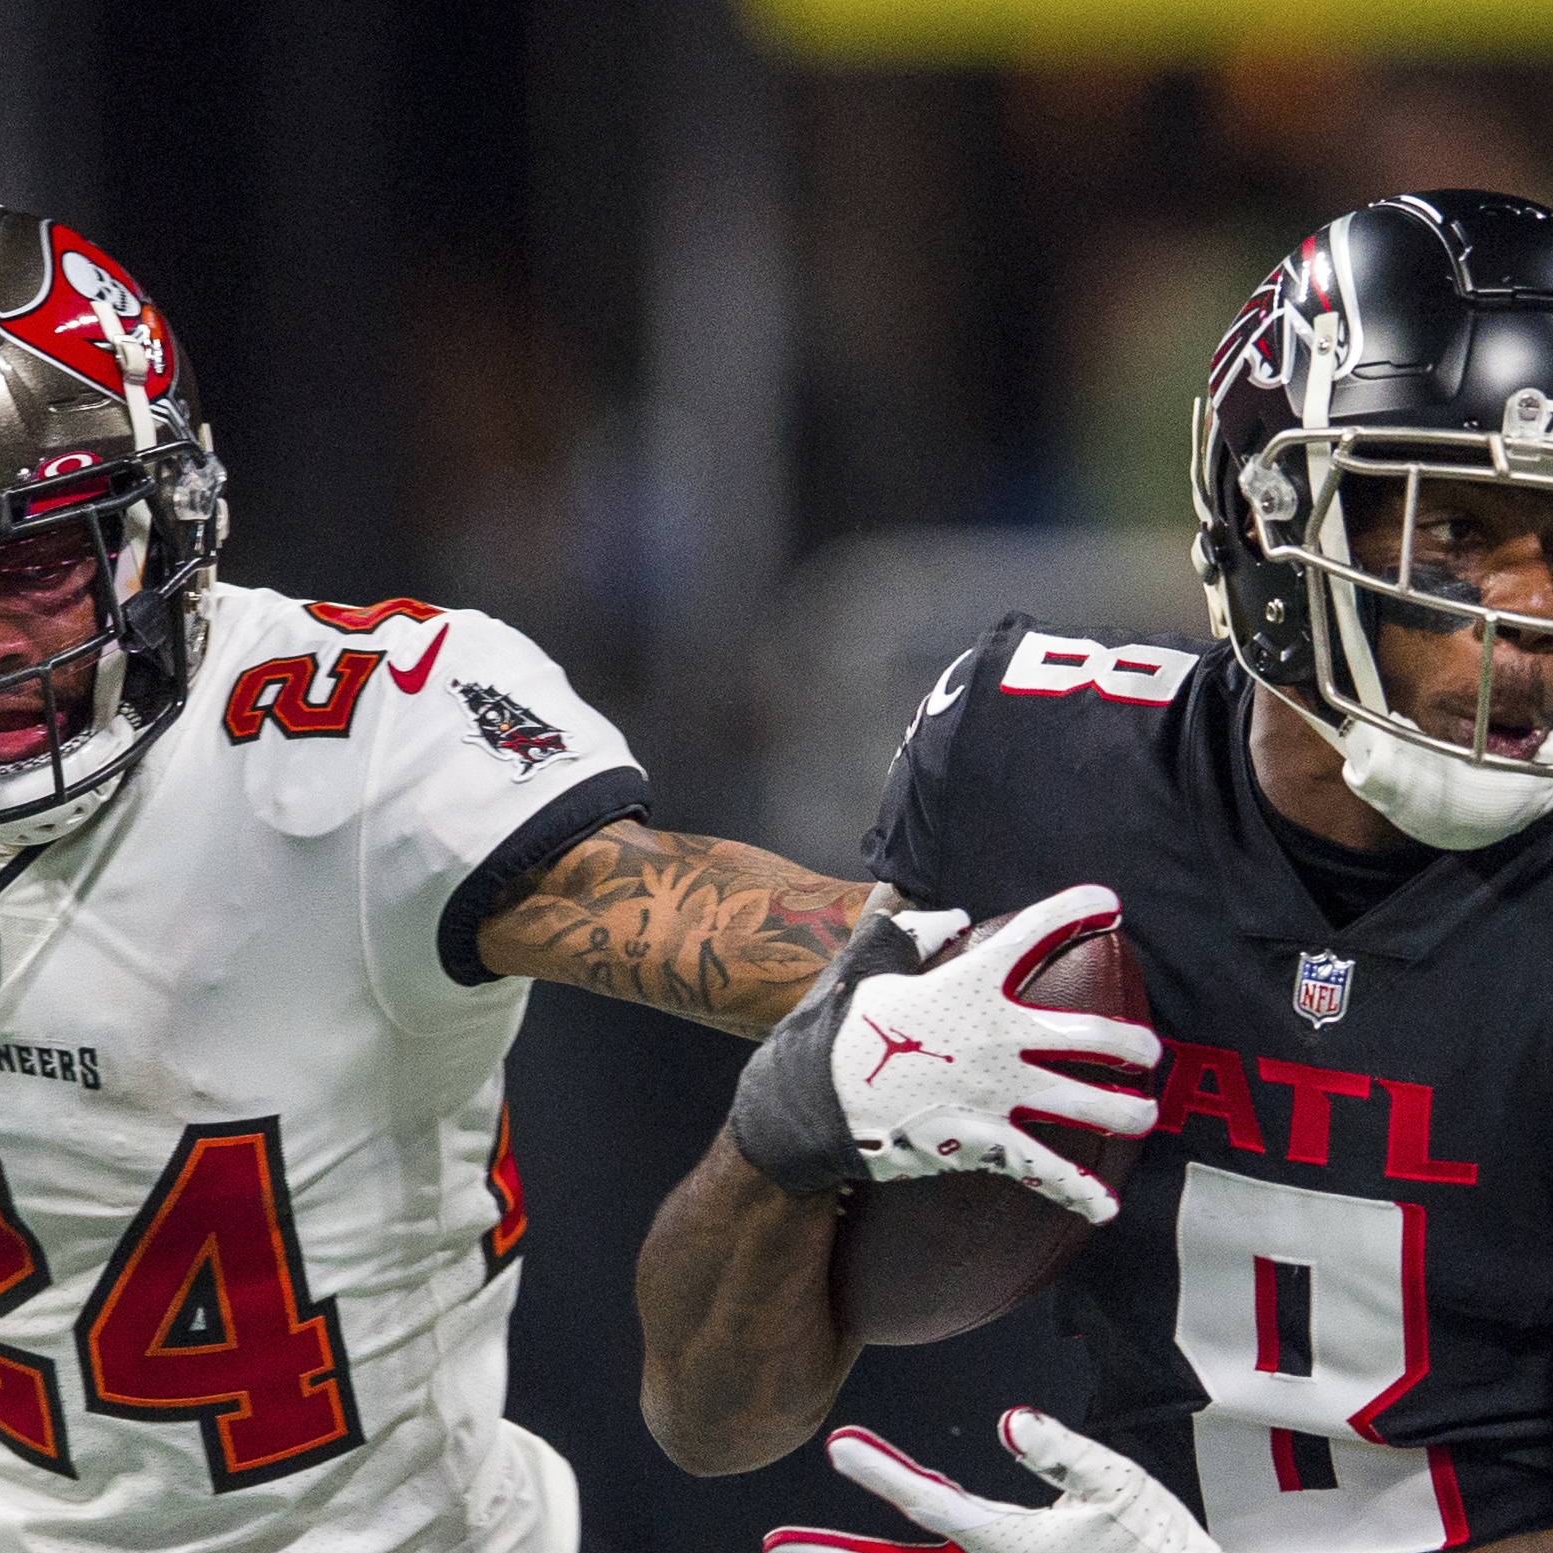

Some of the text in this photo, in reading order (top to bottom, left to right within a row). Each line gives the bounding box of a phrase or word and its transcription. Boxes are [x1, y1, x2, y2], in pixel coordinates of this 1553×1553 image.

[1000, 631, 1200, 708] 8
[1302, 982, 1338, 1015] NFL
[1153, 1037, 1479, 1187] ATL
